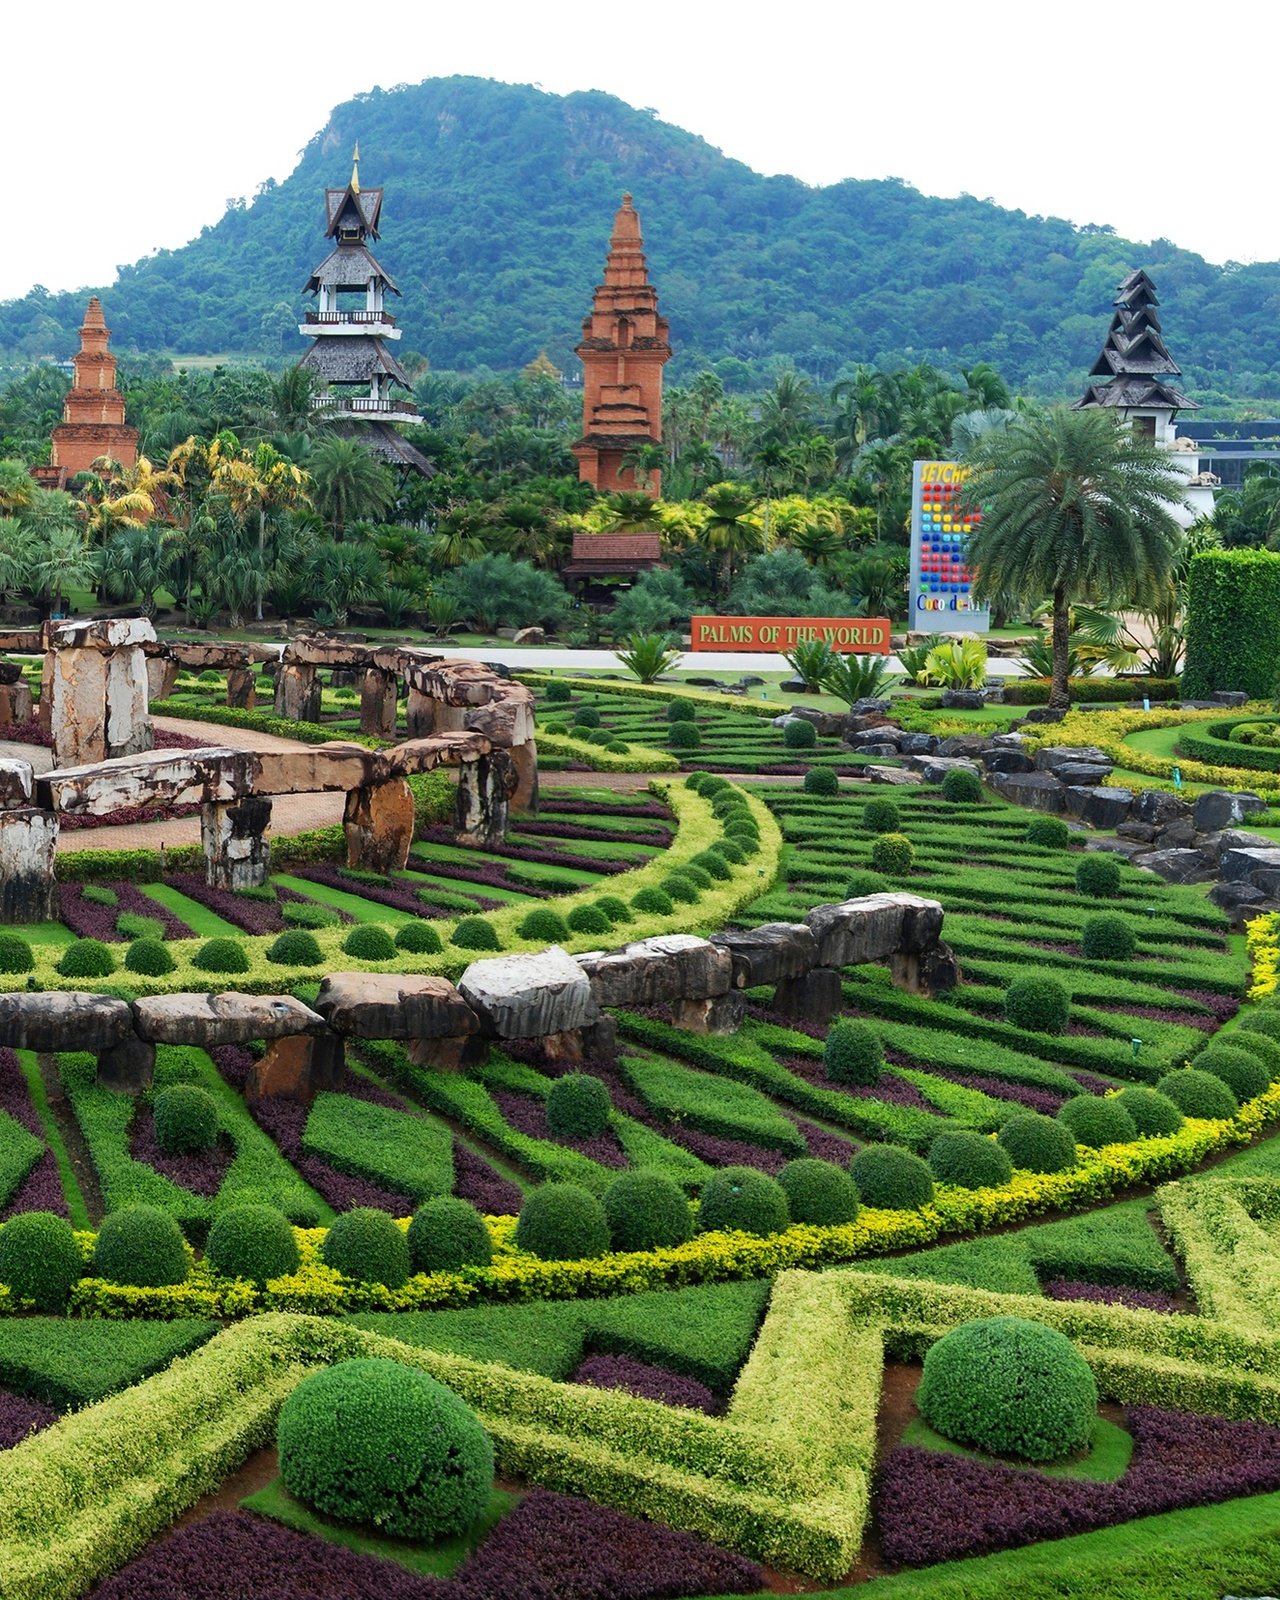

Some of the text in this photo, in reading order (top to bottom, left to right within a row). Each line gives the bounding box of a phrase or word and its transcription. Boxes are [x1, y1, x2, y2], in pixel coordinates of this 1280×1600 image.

[700, 624, 884, 645] PALMS OF THE WORLD
